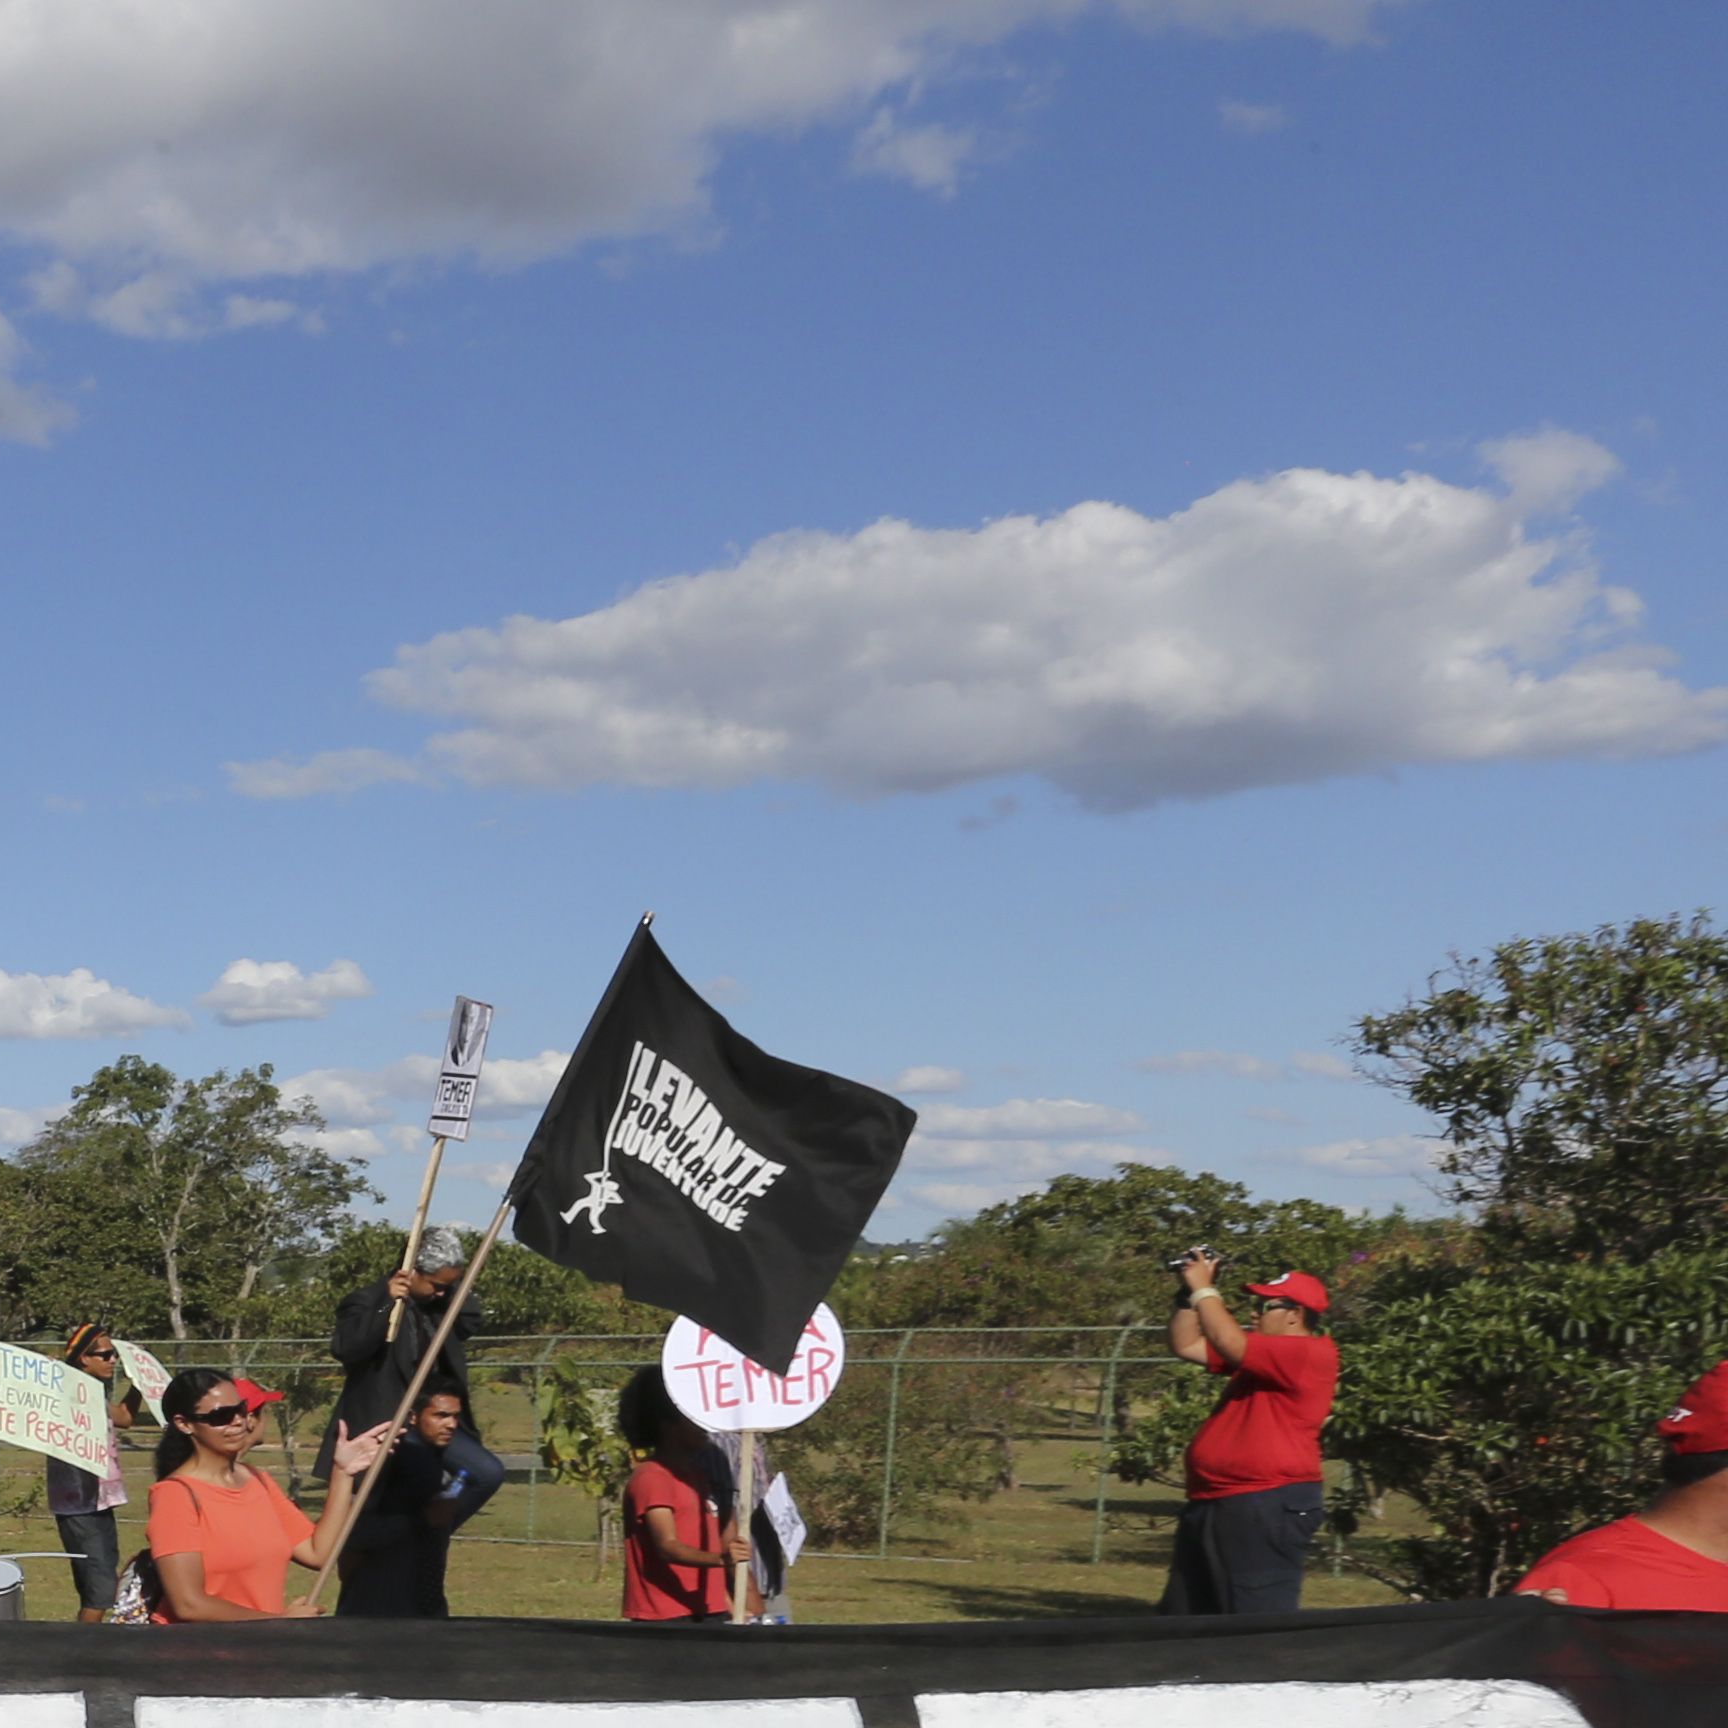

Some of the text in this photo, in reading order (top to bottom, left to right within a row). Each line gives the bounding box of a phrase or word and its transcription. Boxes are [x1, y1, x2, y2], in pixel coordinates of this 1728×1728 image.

[438, 1079, 472, 1104] TEMER
[631, 1046, 787, 1198] LEVANTE
[673, 1346, 837, 1412] TEMER
